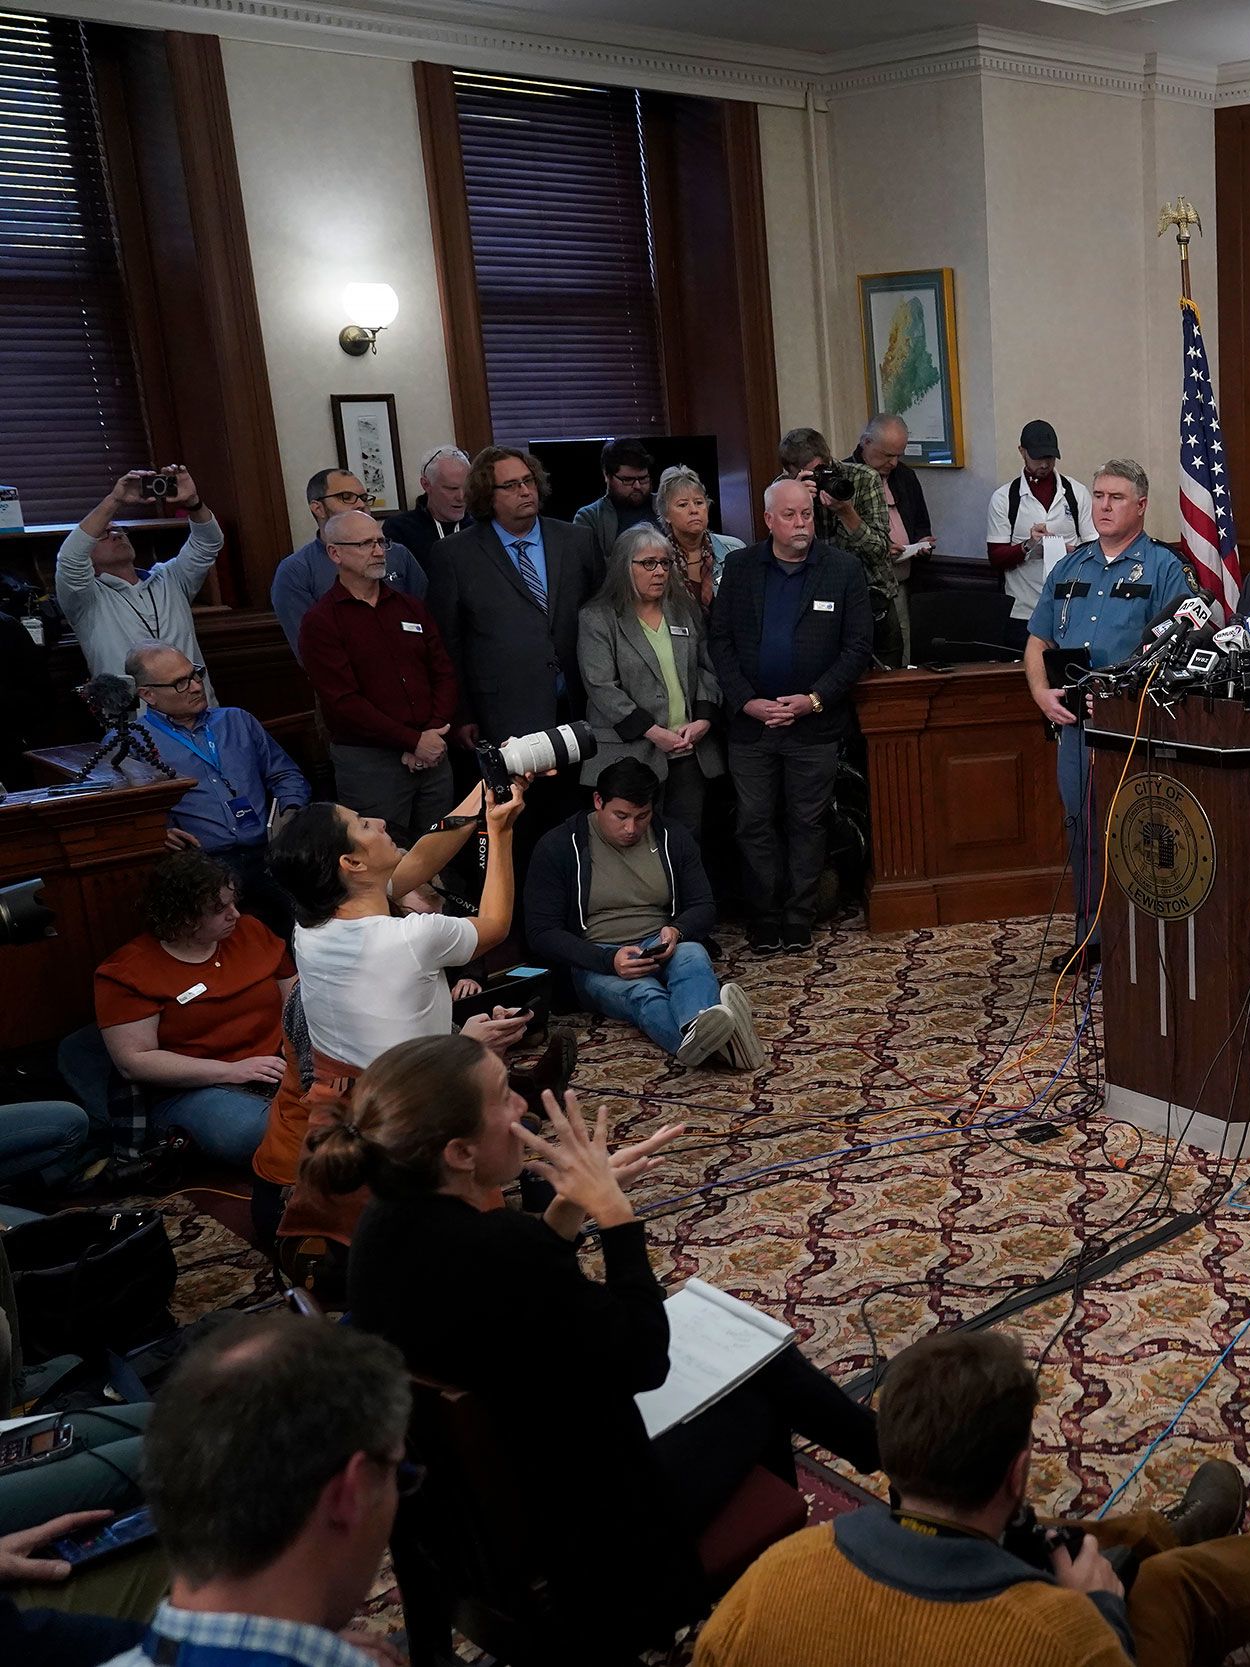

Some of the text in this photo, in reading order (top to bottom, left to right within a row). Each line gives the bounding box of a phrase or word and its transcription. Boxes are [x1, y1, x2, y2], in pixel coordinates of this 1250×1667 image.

[1179, 601, 1195, 611] AP
[1193, 604, 1208, 620] AP
[1134, 780, 1185, 803] CITY OF
[479, 837, 487, 869] SONY
[1128, 881, 1190, 913] LEWISTON
